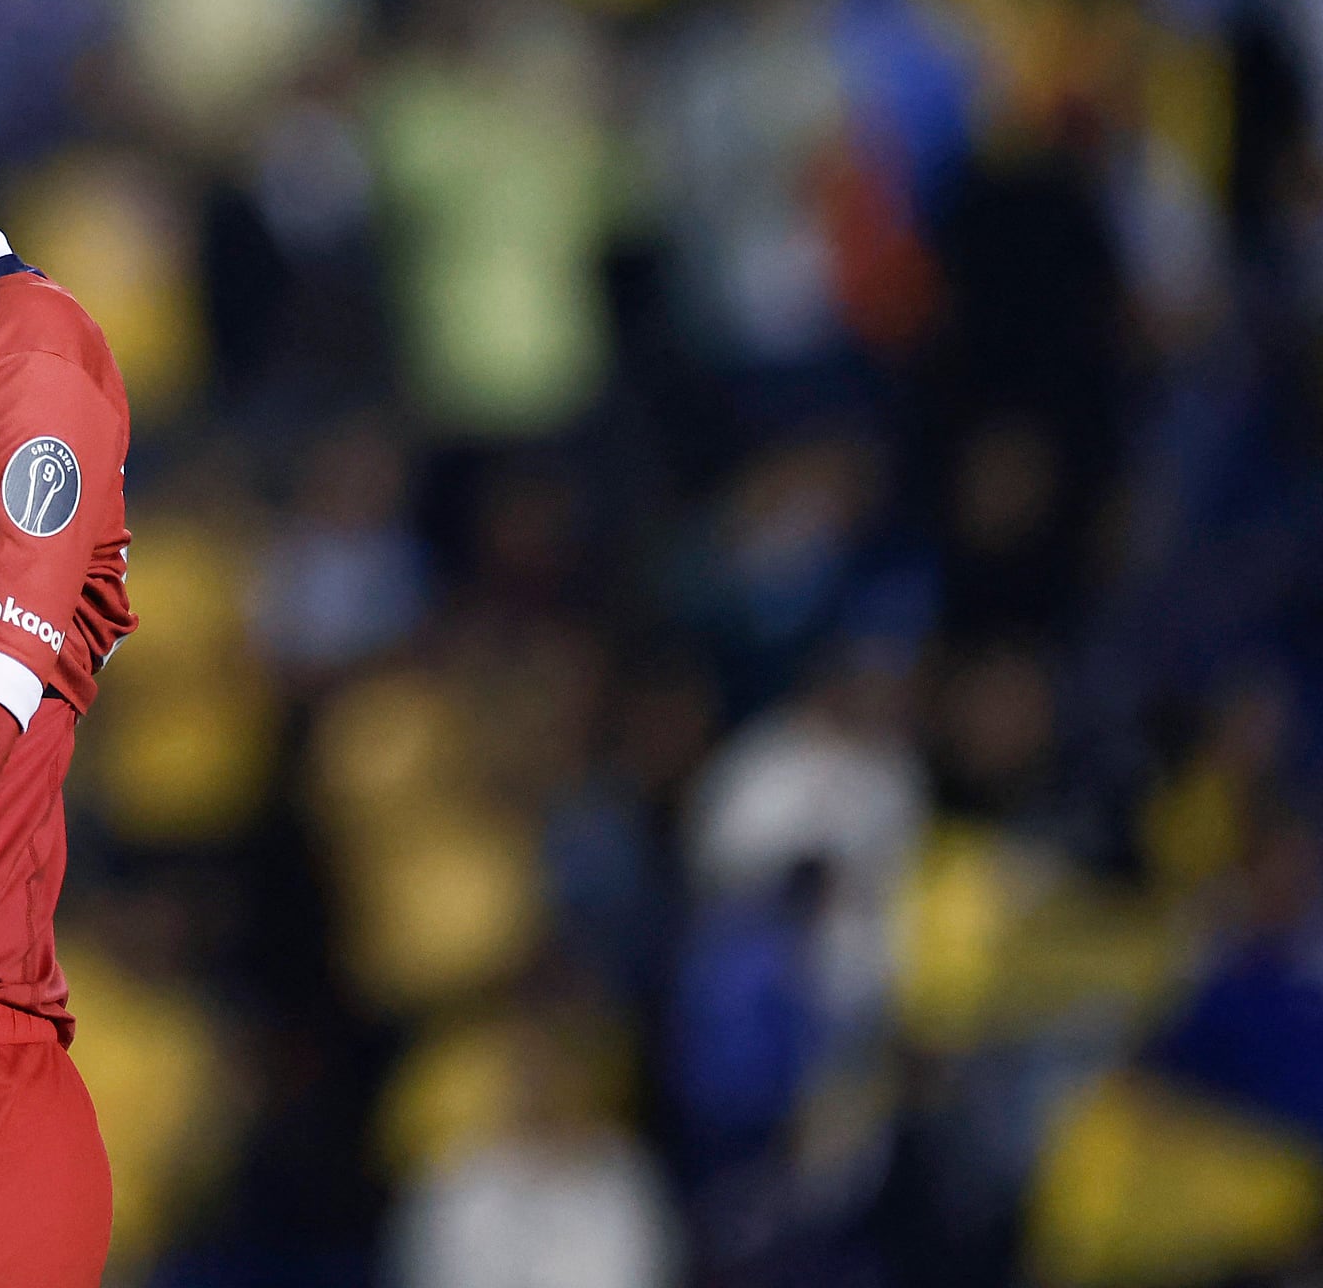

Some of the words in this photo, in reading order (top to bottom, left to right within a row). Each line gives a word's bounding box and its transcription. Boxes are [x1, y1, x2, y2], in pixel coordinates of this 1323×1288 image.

[31, 443, 55, 455] CRUZ
[57, 449, 75, 473] AZUL
[42, 463, 55, 482] 9
